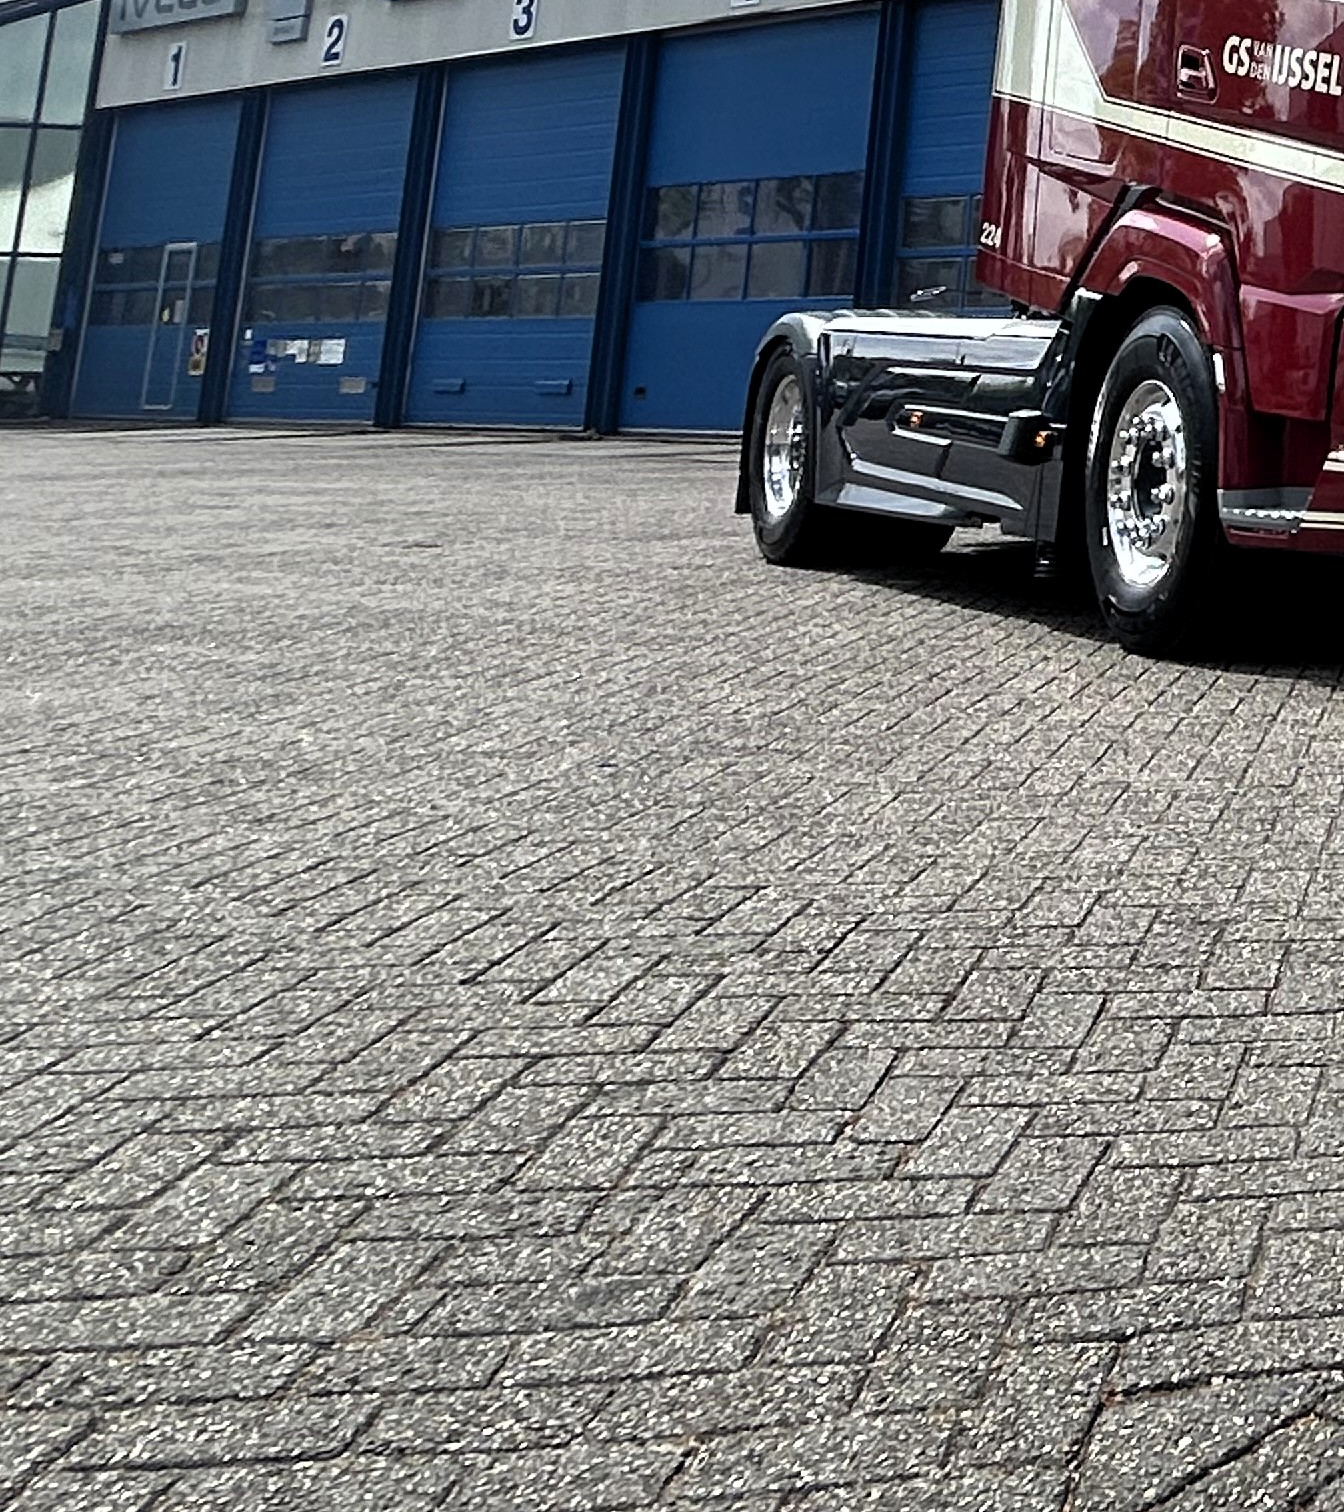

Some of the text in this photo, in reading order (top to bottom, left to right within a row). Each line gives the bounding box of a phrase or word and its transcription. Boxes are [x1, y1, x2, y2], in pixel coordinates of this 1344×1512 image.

[323, 18, 345, 63] 2
[170, 44, 183, 87] 1
[1222, 34, 1343, 96] GS VAN DEN IJSSEL
